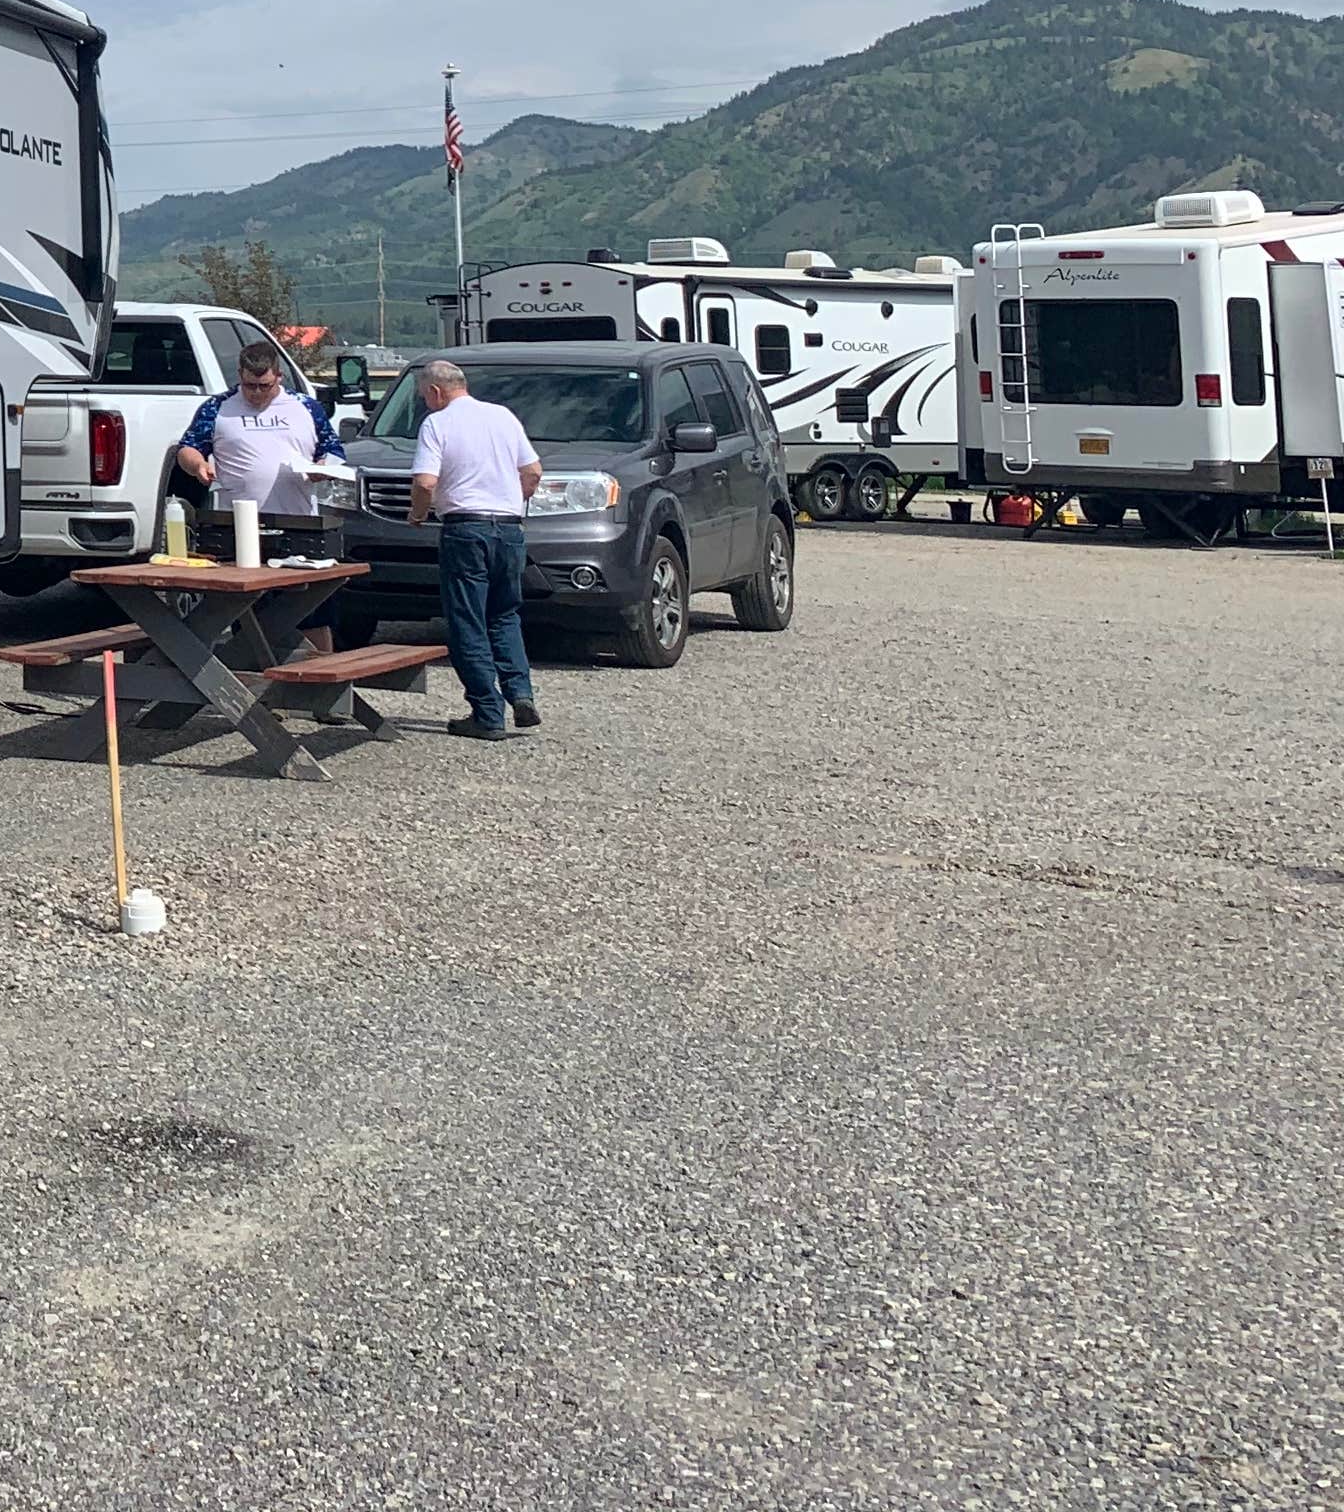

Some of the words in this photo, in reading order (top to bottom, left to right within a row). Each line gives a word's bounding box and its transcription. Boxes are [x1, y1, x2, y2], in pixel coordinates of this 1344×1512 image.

[1043, 267, 1120, 286] Alpenlite
[506, 301, 585, 313] COUGAR
[831, 340, 889, 353] COUGAR
